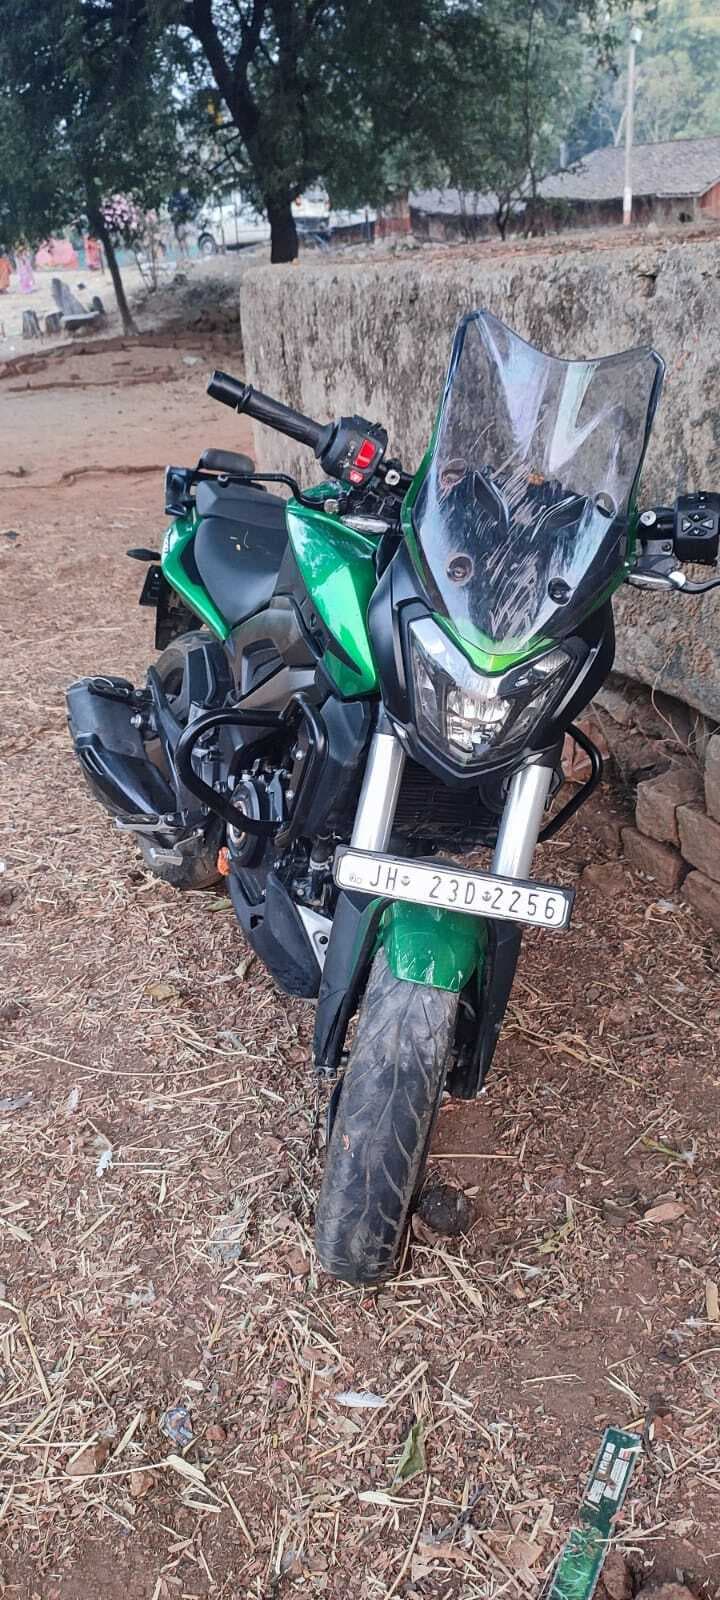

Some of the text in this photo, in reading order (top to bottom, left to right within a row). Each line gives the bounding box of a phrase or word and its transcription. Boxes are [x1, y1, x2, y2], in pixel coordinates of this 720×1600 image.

[369, 865, 398, 890] JH
[429, 875, 475, 904] 23D
[491, 887, 556, 919] 2256
